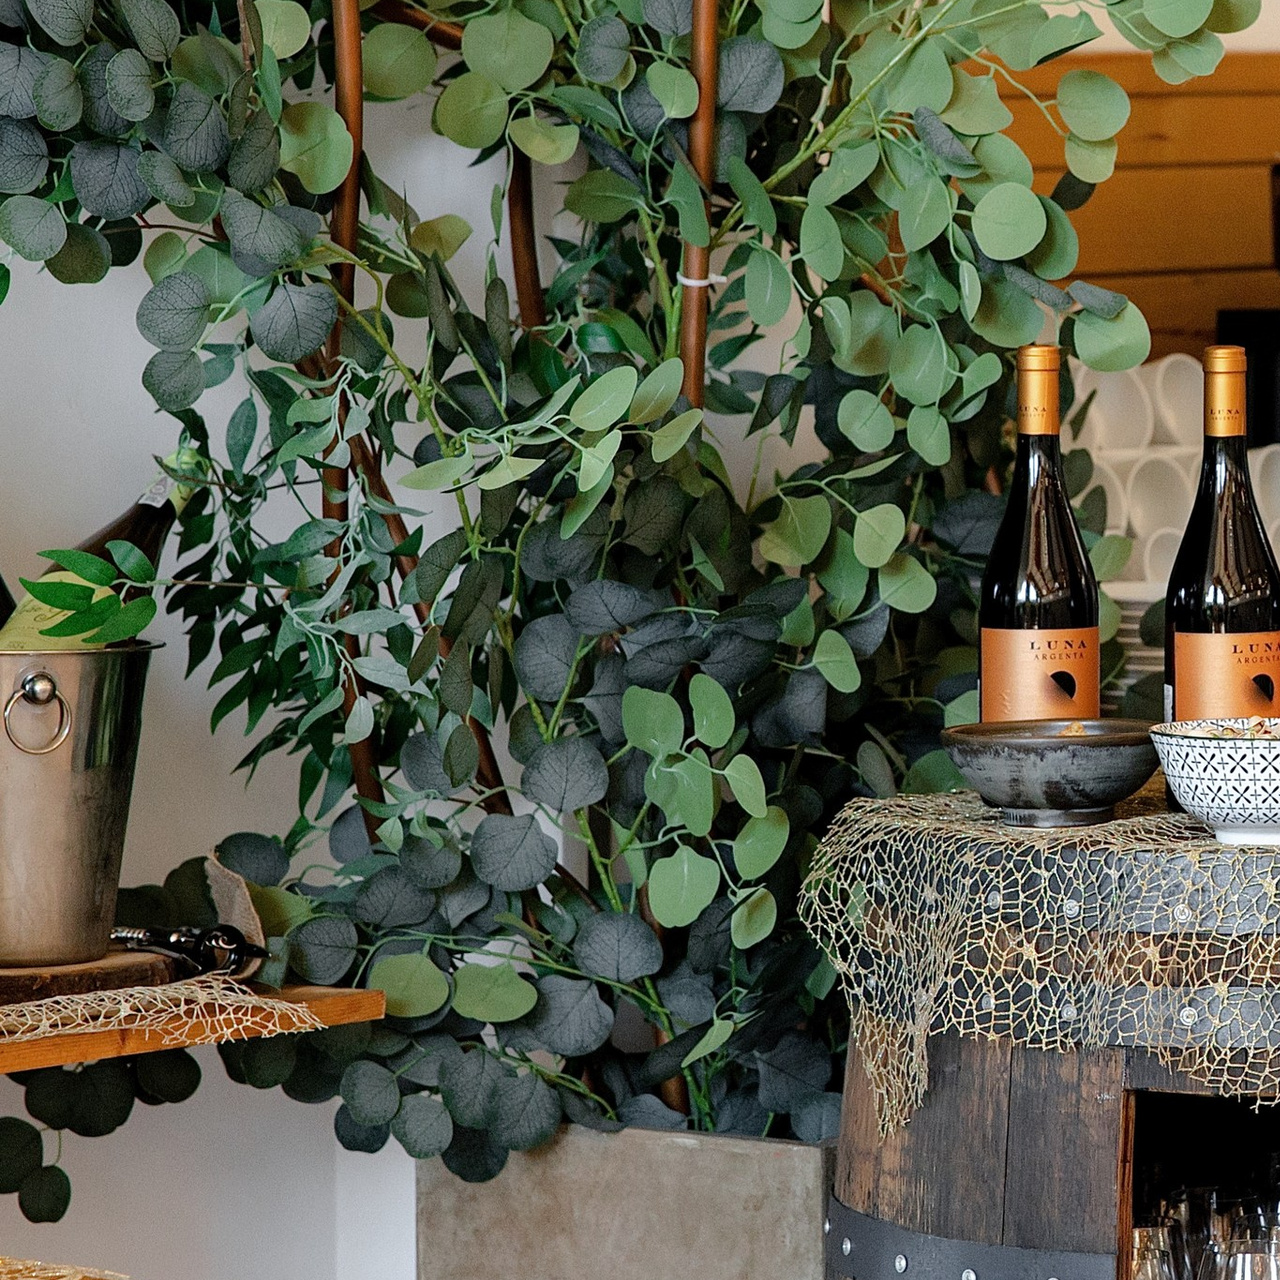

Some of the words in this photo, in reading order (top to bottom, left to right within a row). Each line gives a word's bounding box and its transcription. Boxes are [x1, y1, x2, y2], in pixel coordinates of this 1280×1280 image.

[1029, 639, 1087, 650] LUNA
[1034, 652, 1084, 661] ARGENTA
[1236, 655, 1280, 664] ARGENTA
